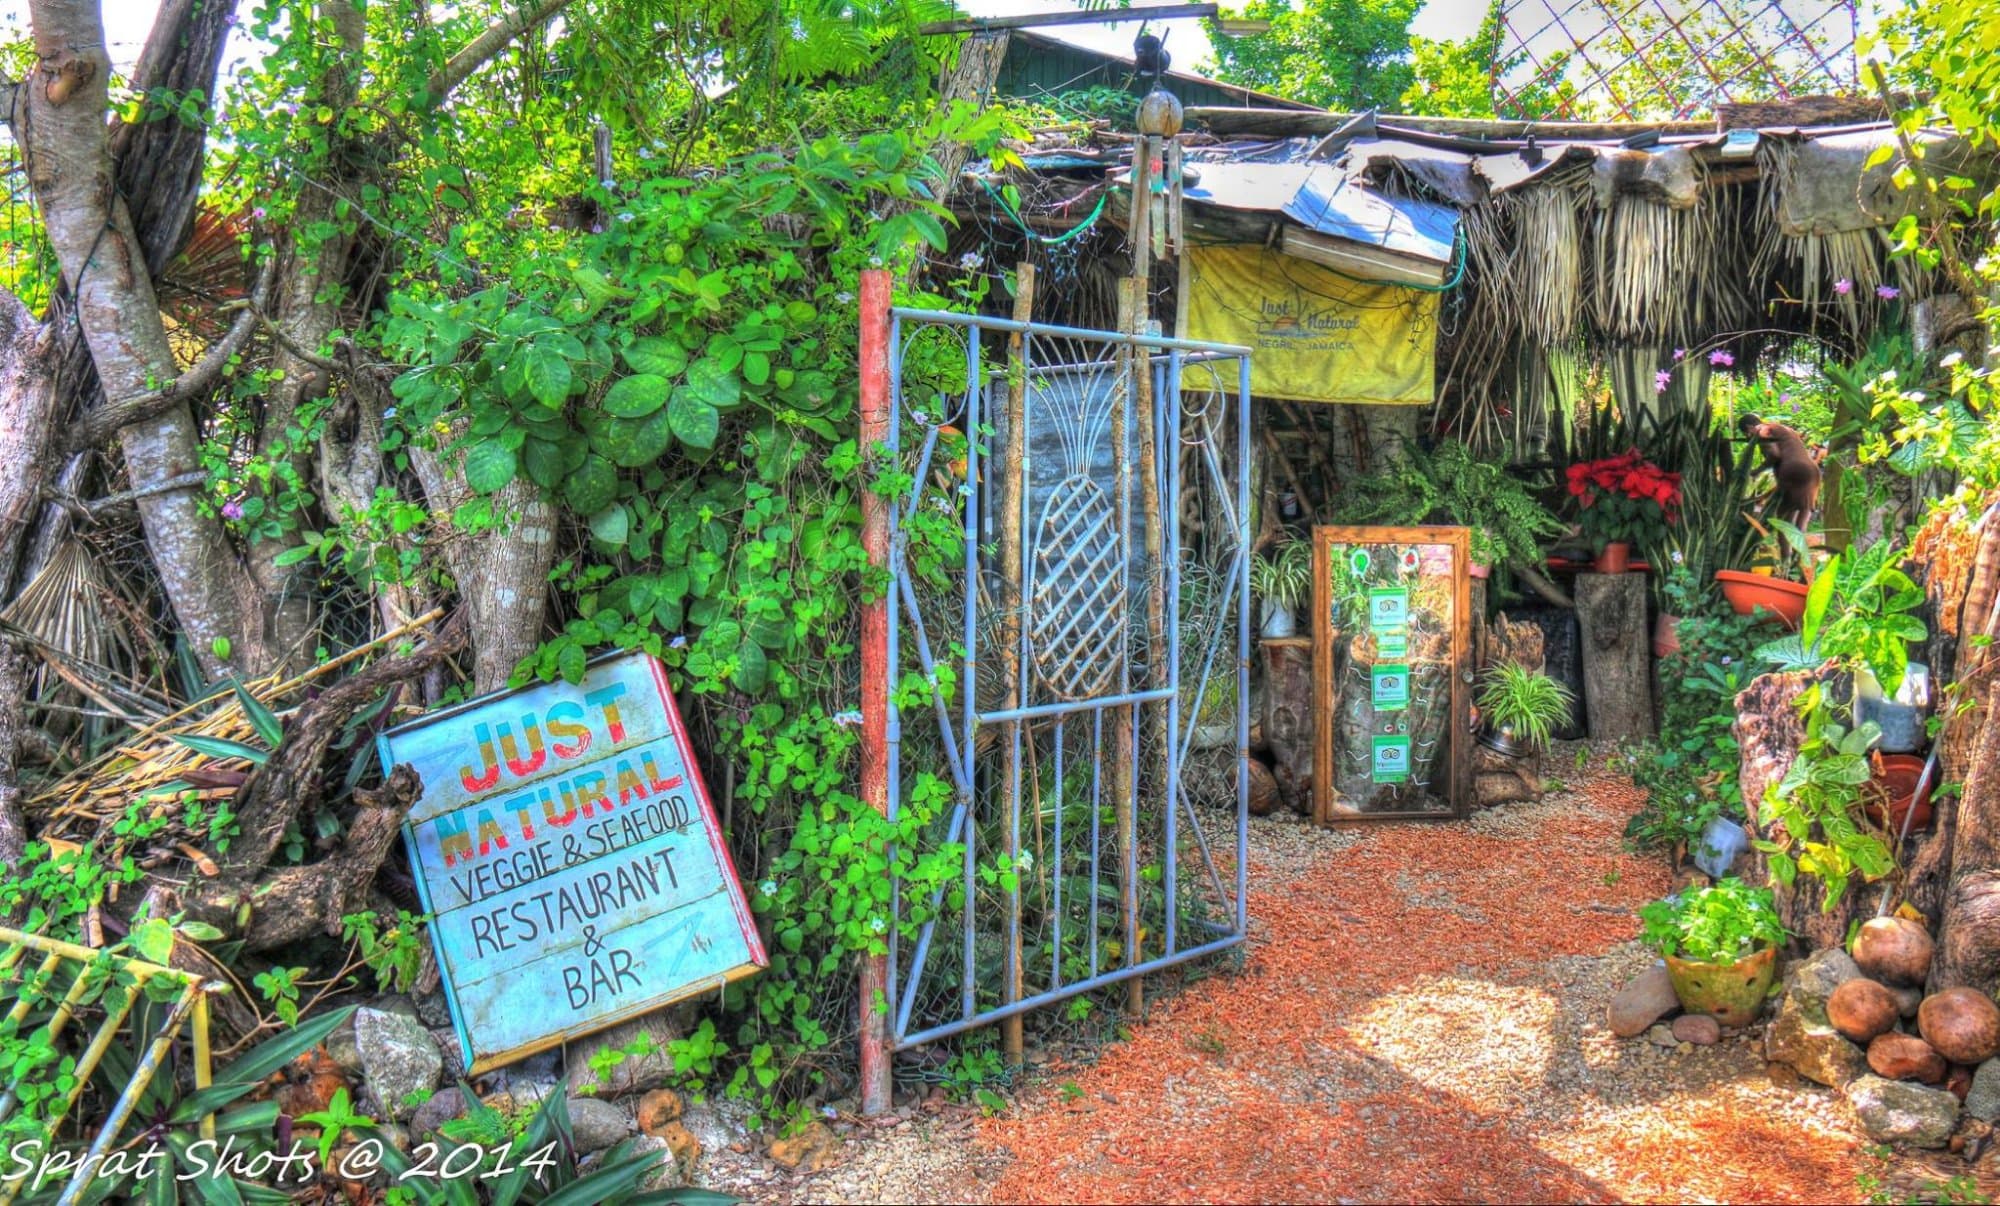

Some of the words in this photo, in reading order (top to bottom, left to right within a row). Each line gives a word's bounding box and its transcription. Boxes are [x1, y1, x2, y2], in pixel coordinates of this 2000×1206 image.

[1262, 296, 1289, 315] Just
[1307, 313, 1360, 330] Natural
[1306, 342, 1354, 351] JAMAICA
[460, 681, 626, 793] JUST
[434, 752, 682, 866] NATURAL
[451, 840, 554, 902] VEGGIE
[562, 834, 589, 866] &
[586, 795, 690, 859] SEAFOOD
[470, 847, 681, 958] RESTAURANT
[583, 924, 605, 957] &
[562, 948, 644, 1011] BAR
